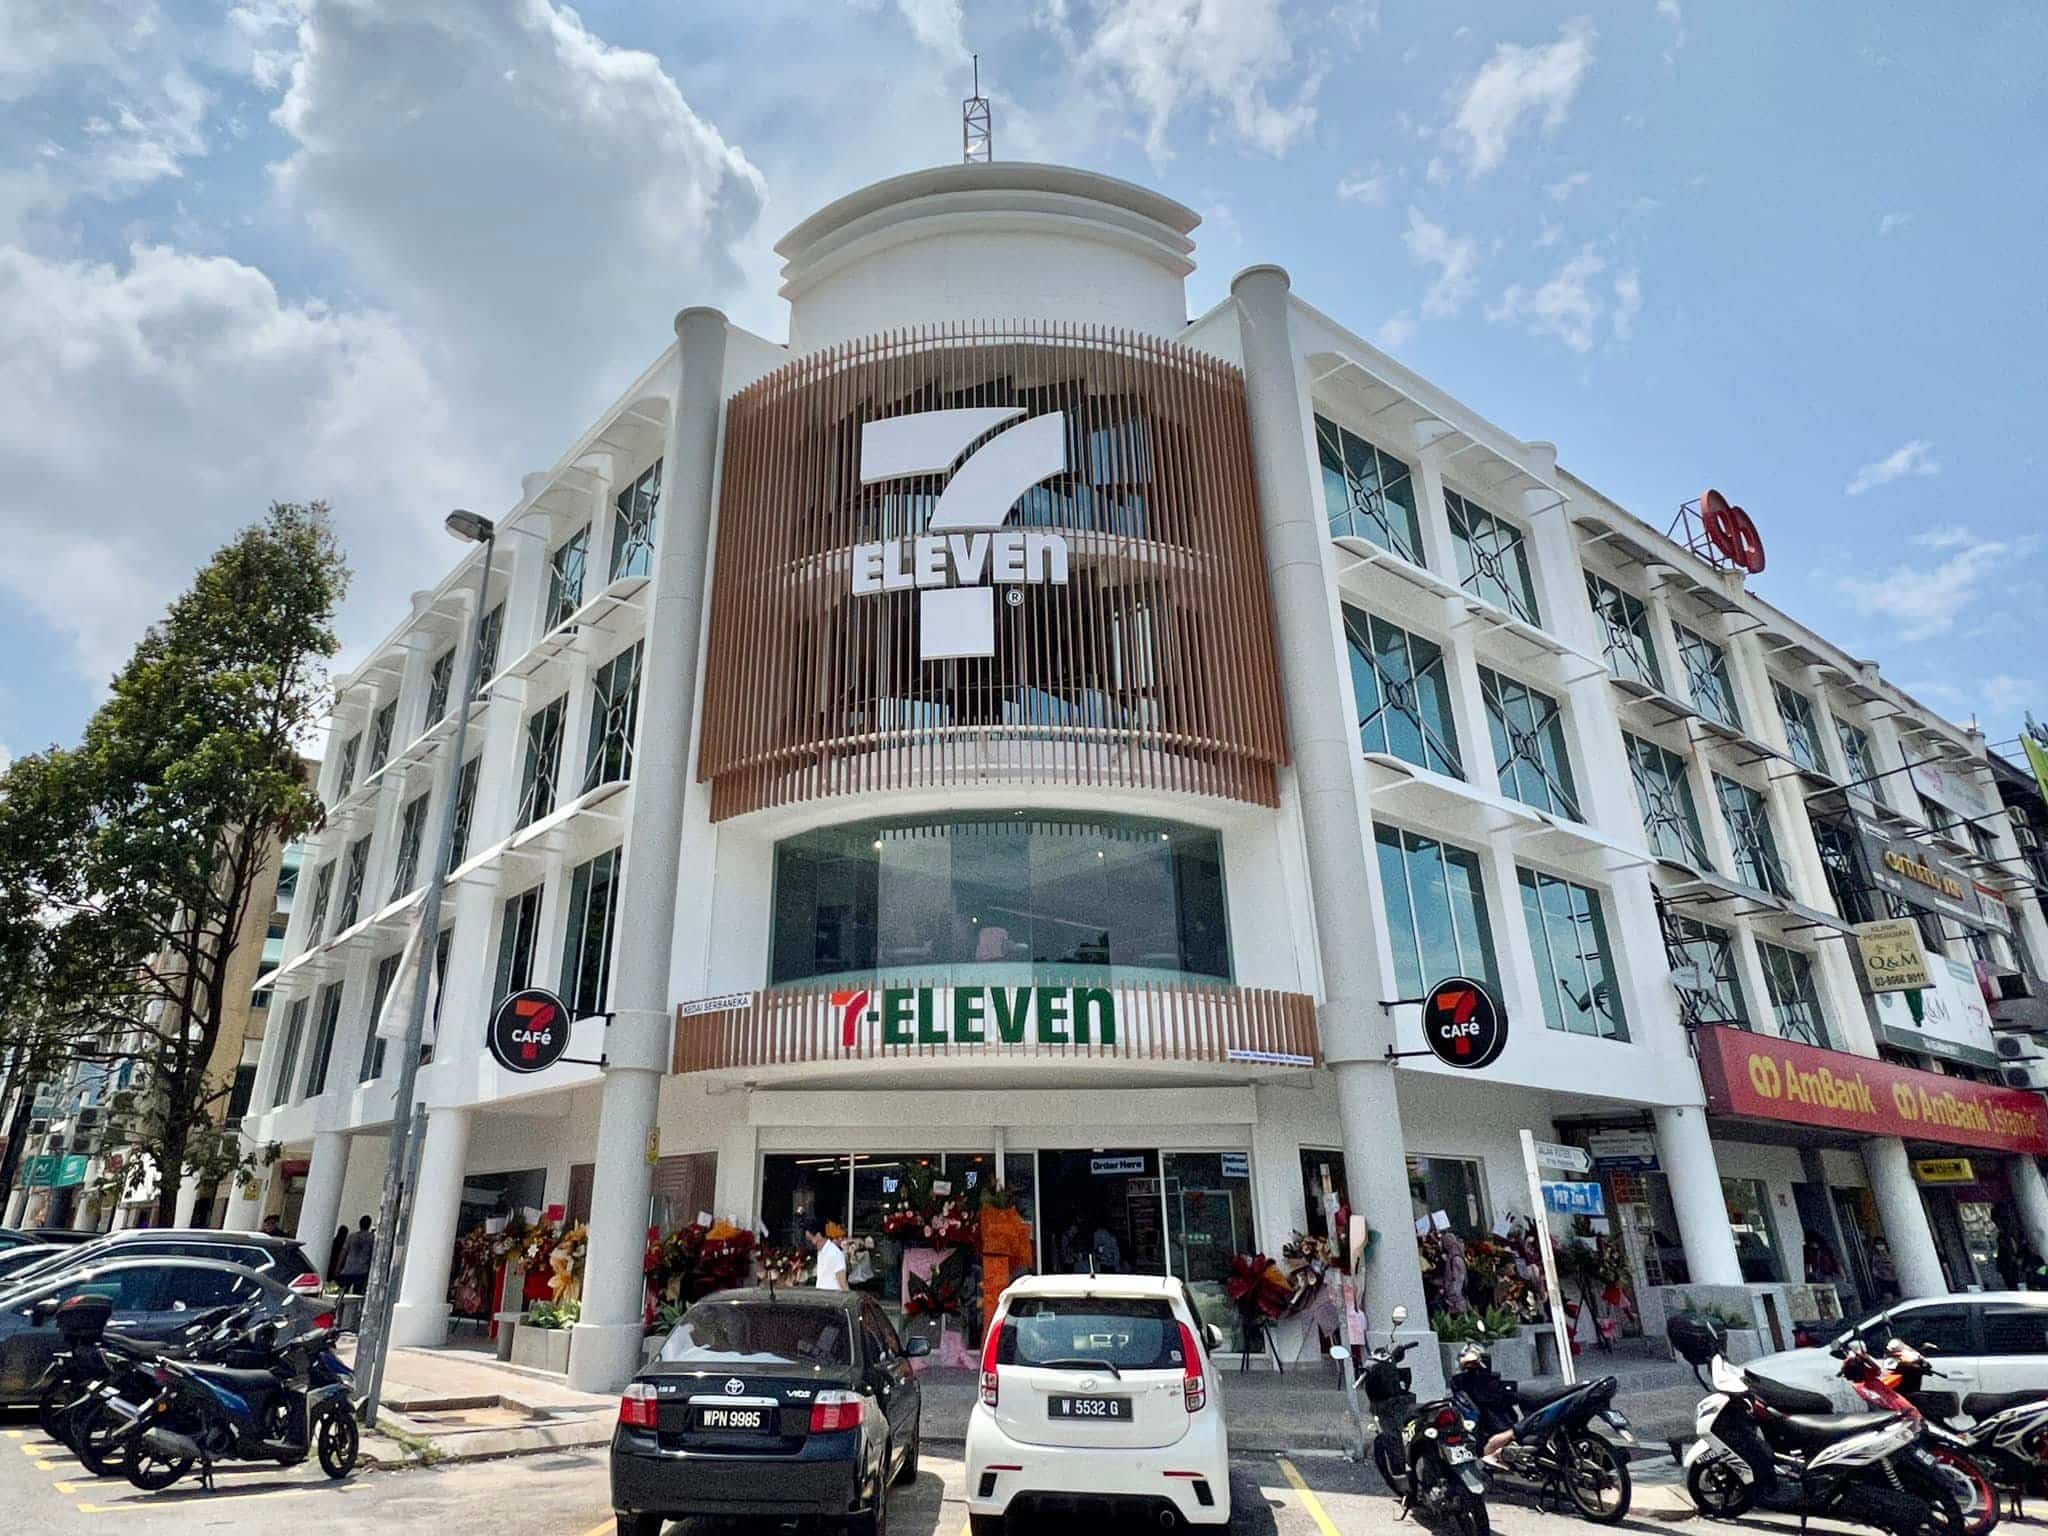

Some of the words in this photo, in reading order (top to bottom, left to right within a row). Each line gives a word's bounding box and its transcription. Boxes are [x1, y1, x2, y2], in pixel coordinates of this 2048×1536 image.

[1869, 952, 1919, 971] Q&M
[1784, 1060, 1877, 1114] AmBank
[1921, 1087, 1988, 1131] AmBank
[1093, 1160, 1119, 1170] Order
[1120, 1159, 1142, 1169] Here
[1062, 1399, 1070, 1414] W
[1075, 1400, 1105, 1415] 5532
[1110, 1401, 1119, 1416] G
[704, 1410, 728, 1427] WPN
[729, 1411, 760, 1427] 9985
